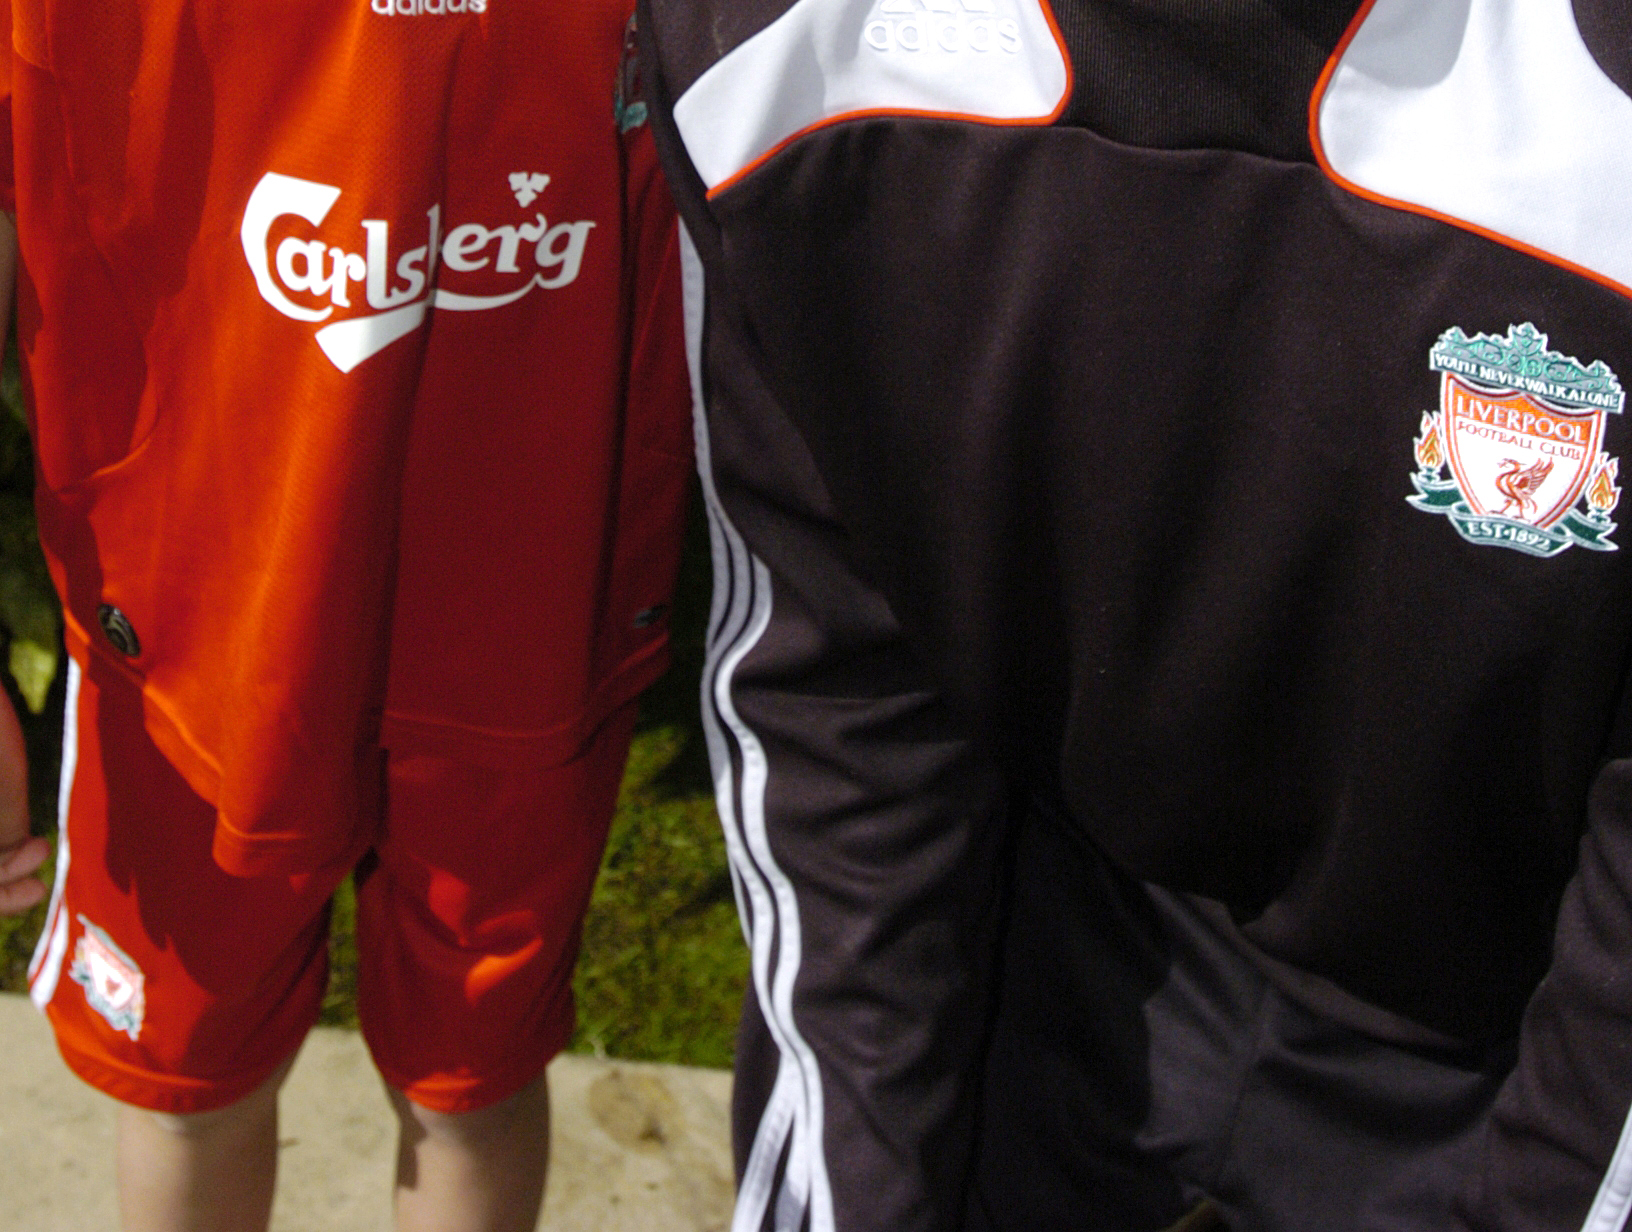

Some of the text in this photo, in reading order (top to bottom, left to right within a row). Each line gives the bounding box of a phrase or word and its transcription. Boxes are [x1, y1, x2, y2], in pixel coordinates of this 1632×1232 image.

[864, 10, 1024, 55] adidas
[1524, 377, 1567, 399] WALK
[1566, 388, 1619, 408] ALONE
[1456, 395, 1587, 445] LIVERPOOL
[1456, 420, 1582, 461] FOOTBALL CLUB
